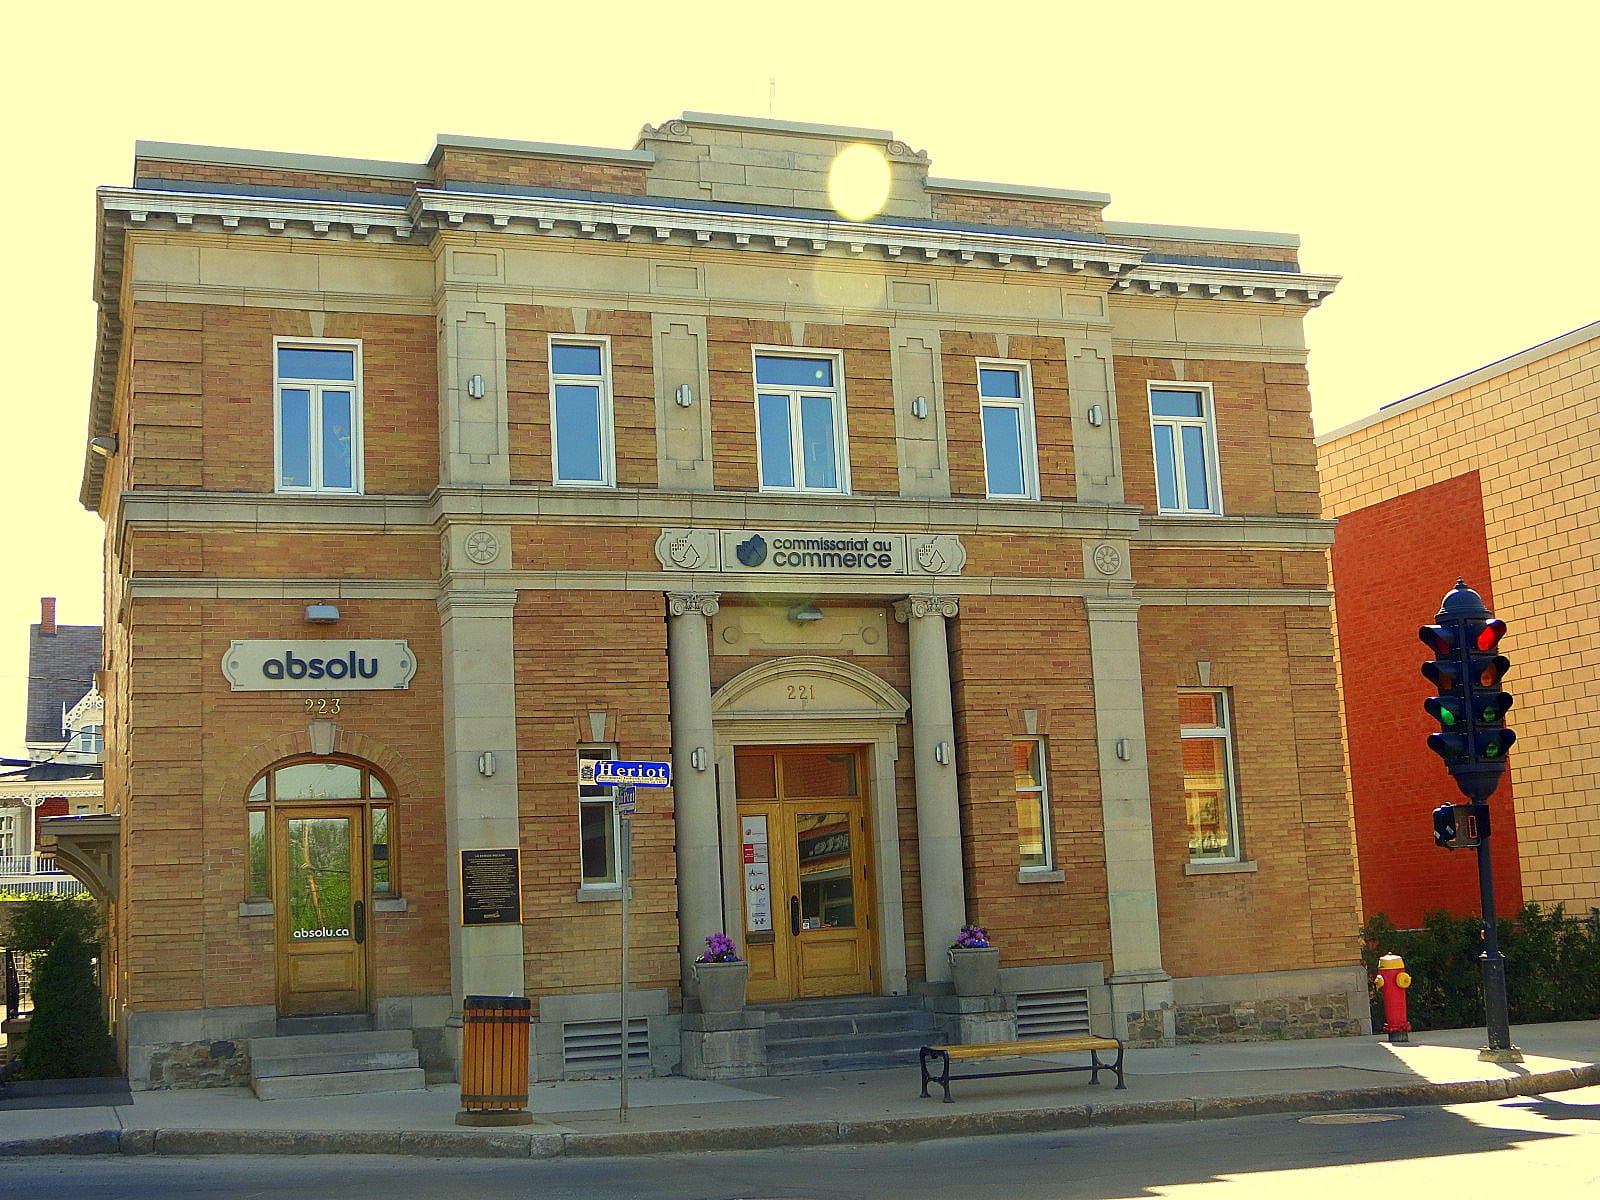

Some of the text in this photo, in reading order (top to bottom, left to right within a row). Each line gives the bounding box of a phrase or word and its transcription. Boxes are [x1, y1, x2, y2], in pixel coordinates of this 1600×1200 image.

[773, 537, 892, 551] commissariat au
[773, 551, 892, 568] commerce
[262, 651, 378, 679] absolu
[787, 685, 815, 700] 221
[305, 699, 341, 715] 223
[600, 763, 665, 777] Heriot
[293, 926, 349, 938] absolu.ca
